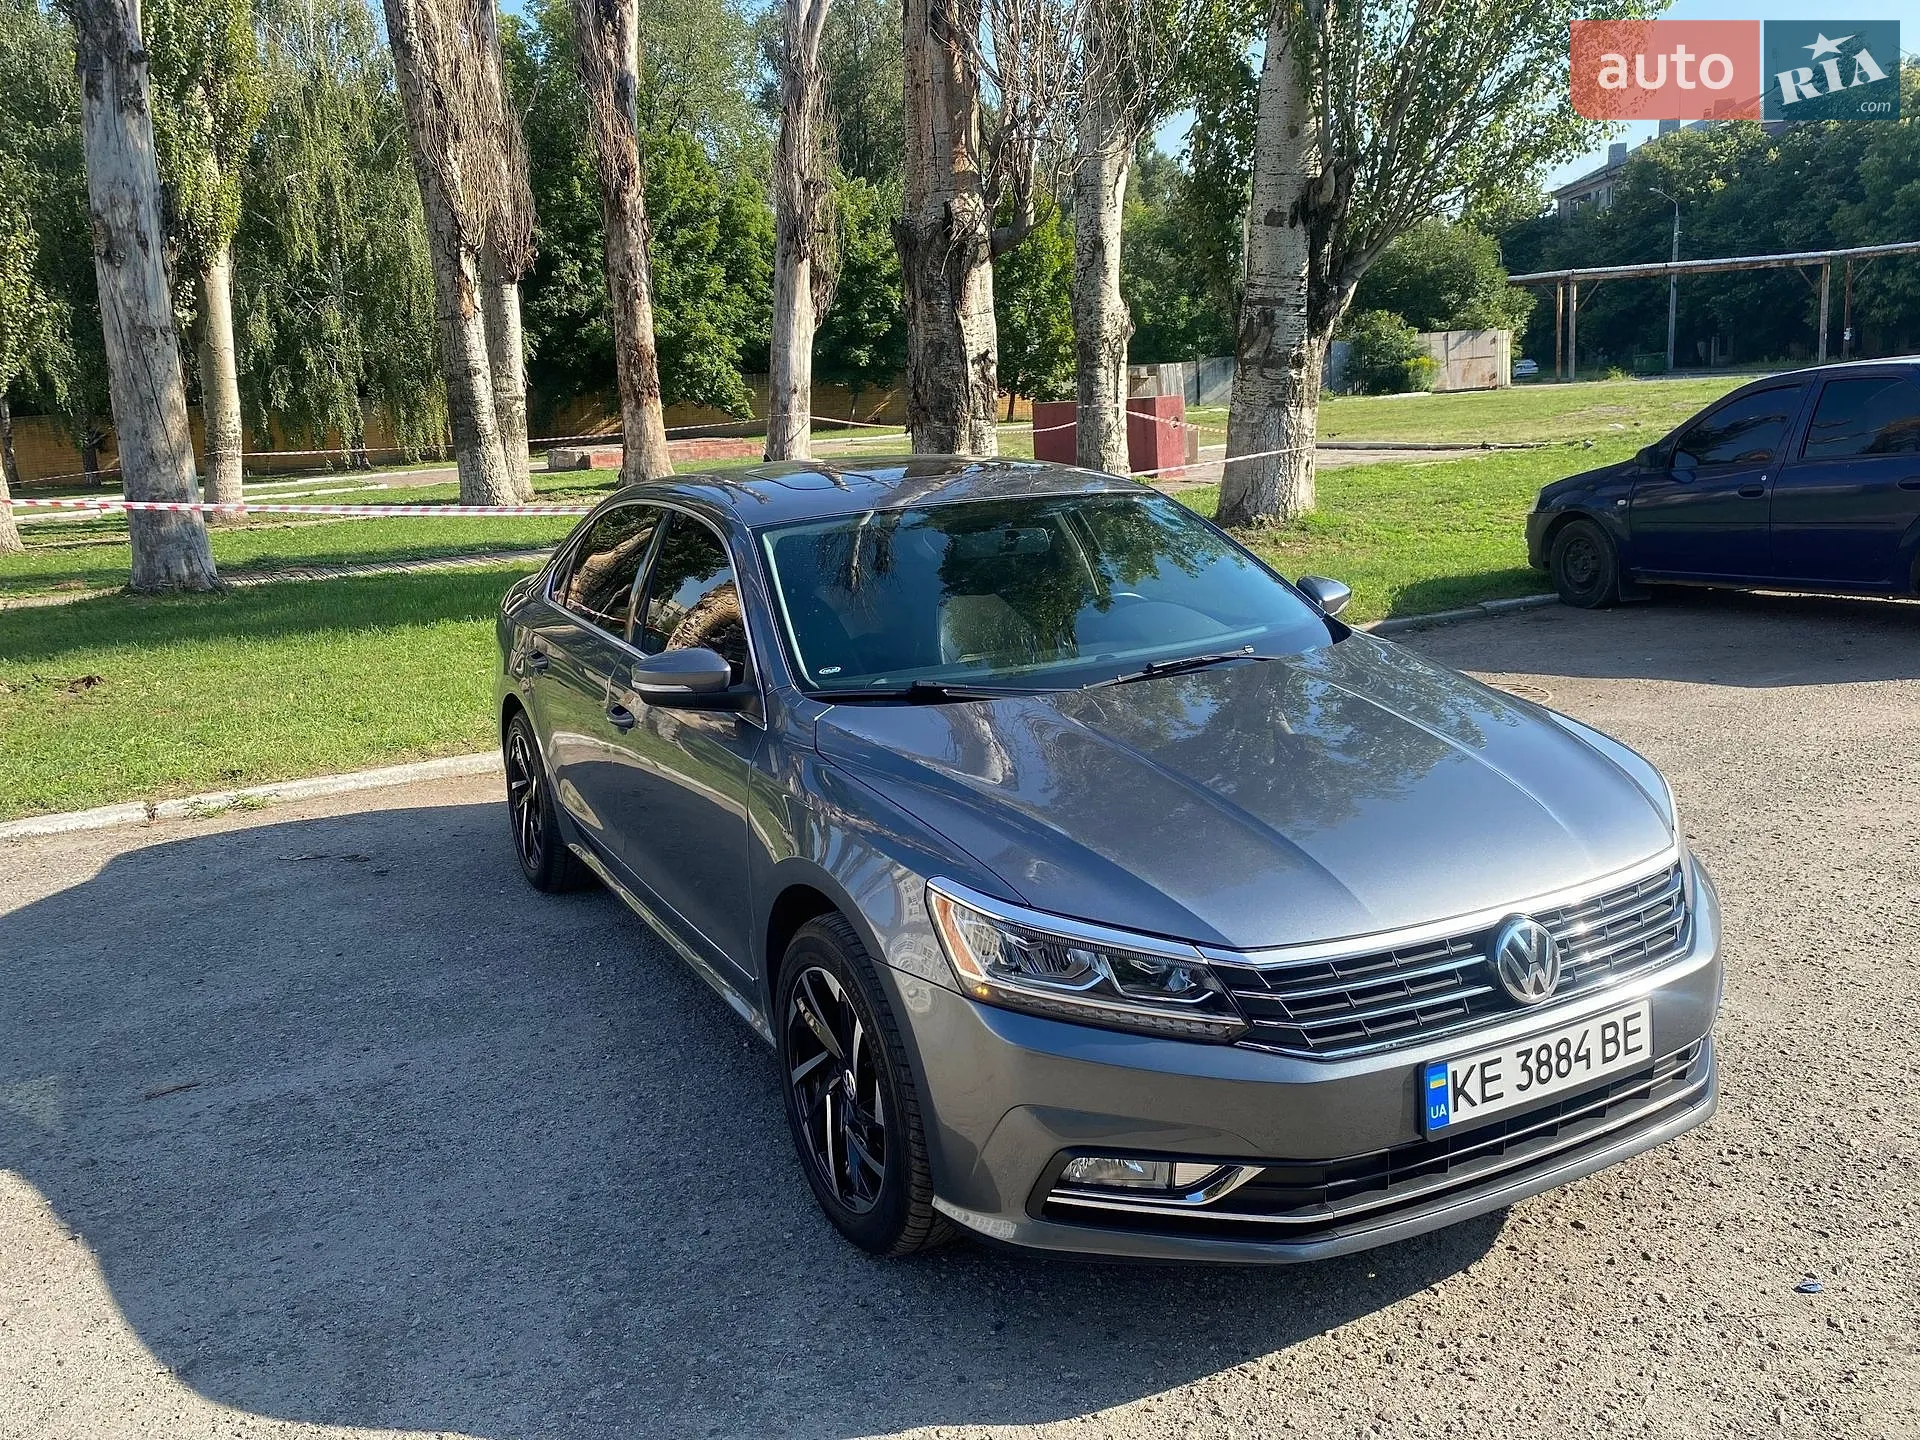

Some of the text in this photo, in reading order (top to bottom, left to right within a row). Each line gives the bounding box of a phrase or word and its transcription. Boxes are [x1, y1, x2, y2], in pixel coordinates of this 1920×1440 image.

[1452, 1012, 1643, 1112] KE 3884 BE
[1431, 1104, 1447, 1119] UA
